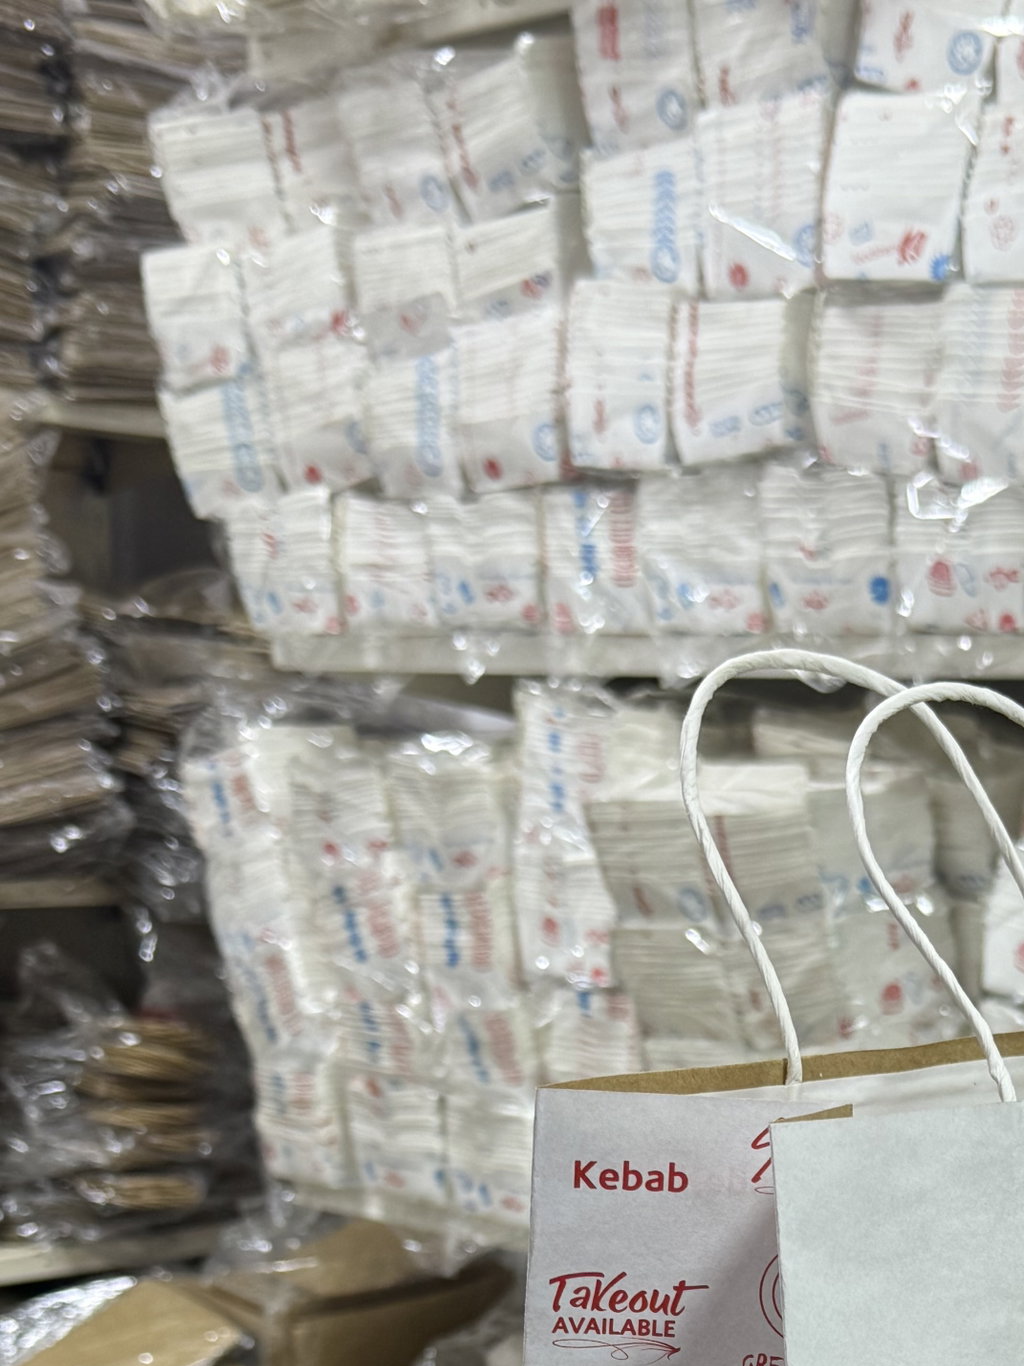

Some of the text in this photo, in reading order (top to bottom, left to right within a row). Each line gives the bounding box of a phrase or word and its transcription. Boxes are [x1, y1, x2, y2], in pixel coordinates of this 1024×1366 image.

[573, 1160, 689, 1193] Kebab
[549, 1271, 709, 1317] Takeout
[551, 1317, 676, 1338] AVAILABLE
